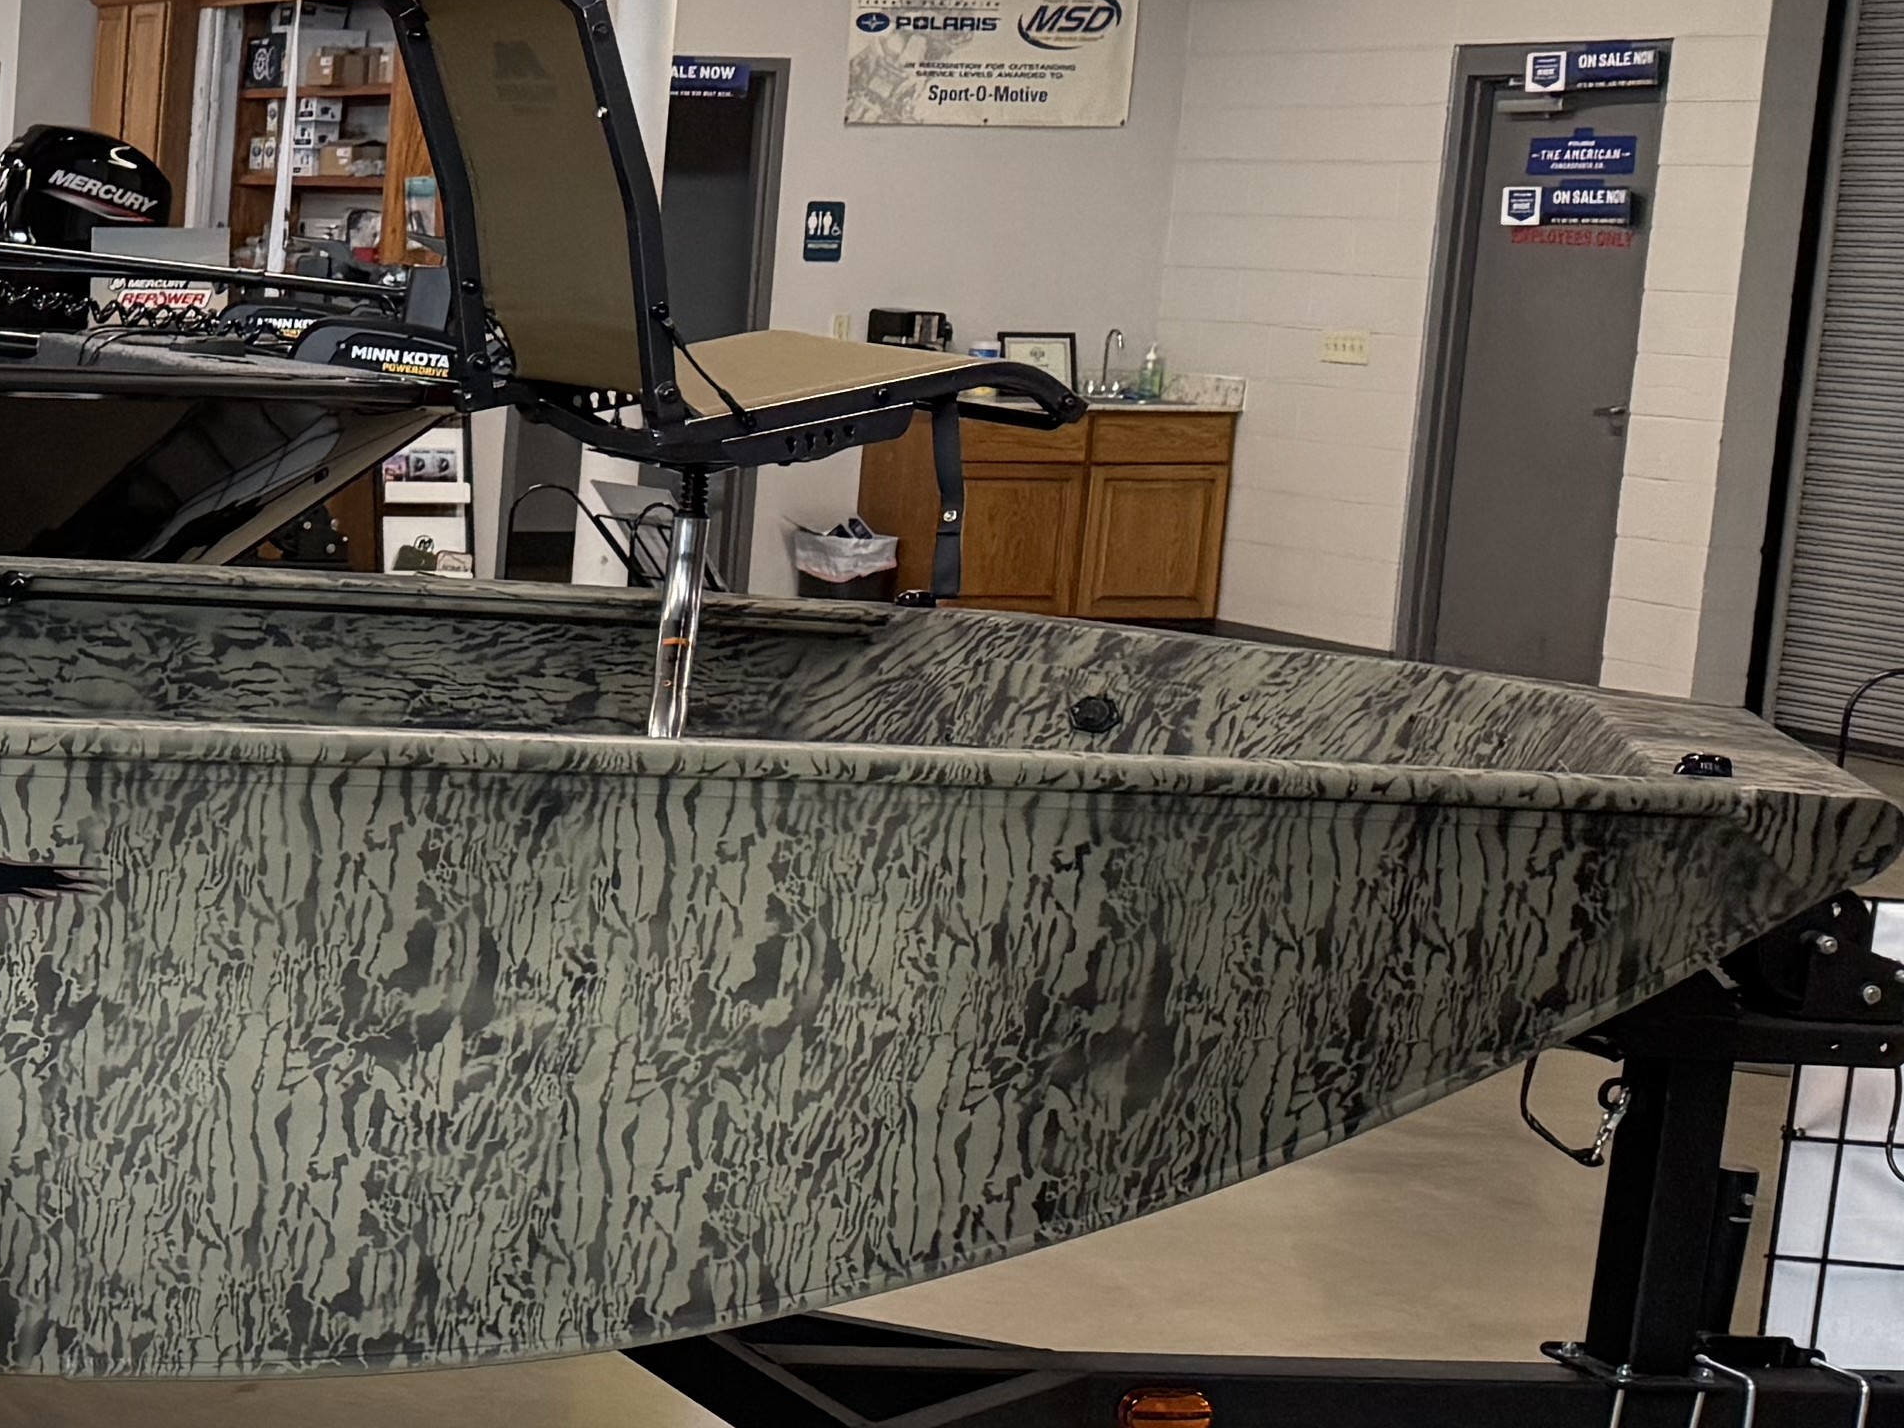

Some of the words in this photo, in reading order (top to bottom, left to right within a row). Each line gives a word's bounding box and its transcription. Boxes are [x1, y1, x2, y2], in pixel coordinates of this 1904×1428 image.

[895, 15, 999, 32] POLARIS
[1025, 4, 1115, 33] MSD
[1578, 54, 1597, 69] ON
[1598, 52, 1632, 68] SALE
[671, 65, 697, 79] ALE
[699, 66, 735, 80] NOW
[928, 84, 1049, 105] Sport-O-Motive
[1563, 147, 1622, 161] AMERICAN
[48, 169, 159, 213] MERCURY
[1552, 190, 1571, 204] ON
[1572, 189, 1604, 204] SALE
[121, 289, 207, 309] REPOWER
[351, 344, 395, 364] MINN
[402, 349, 451, 369] KOTA
